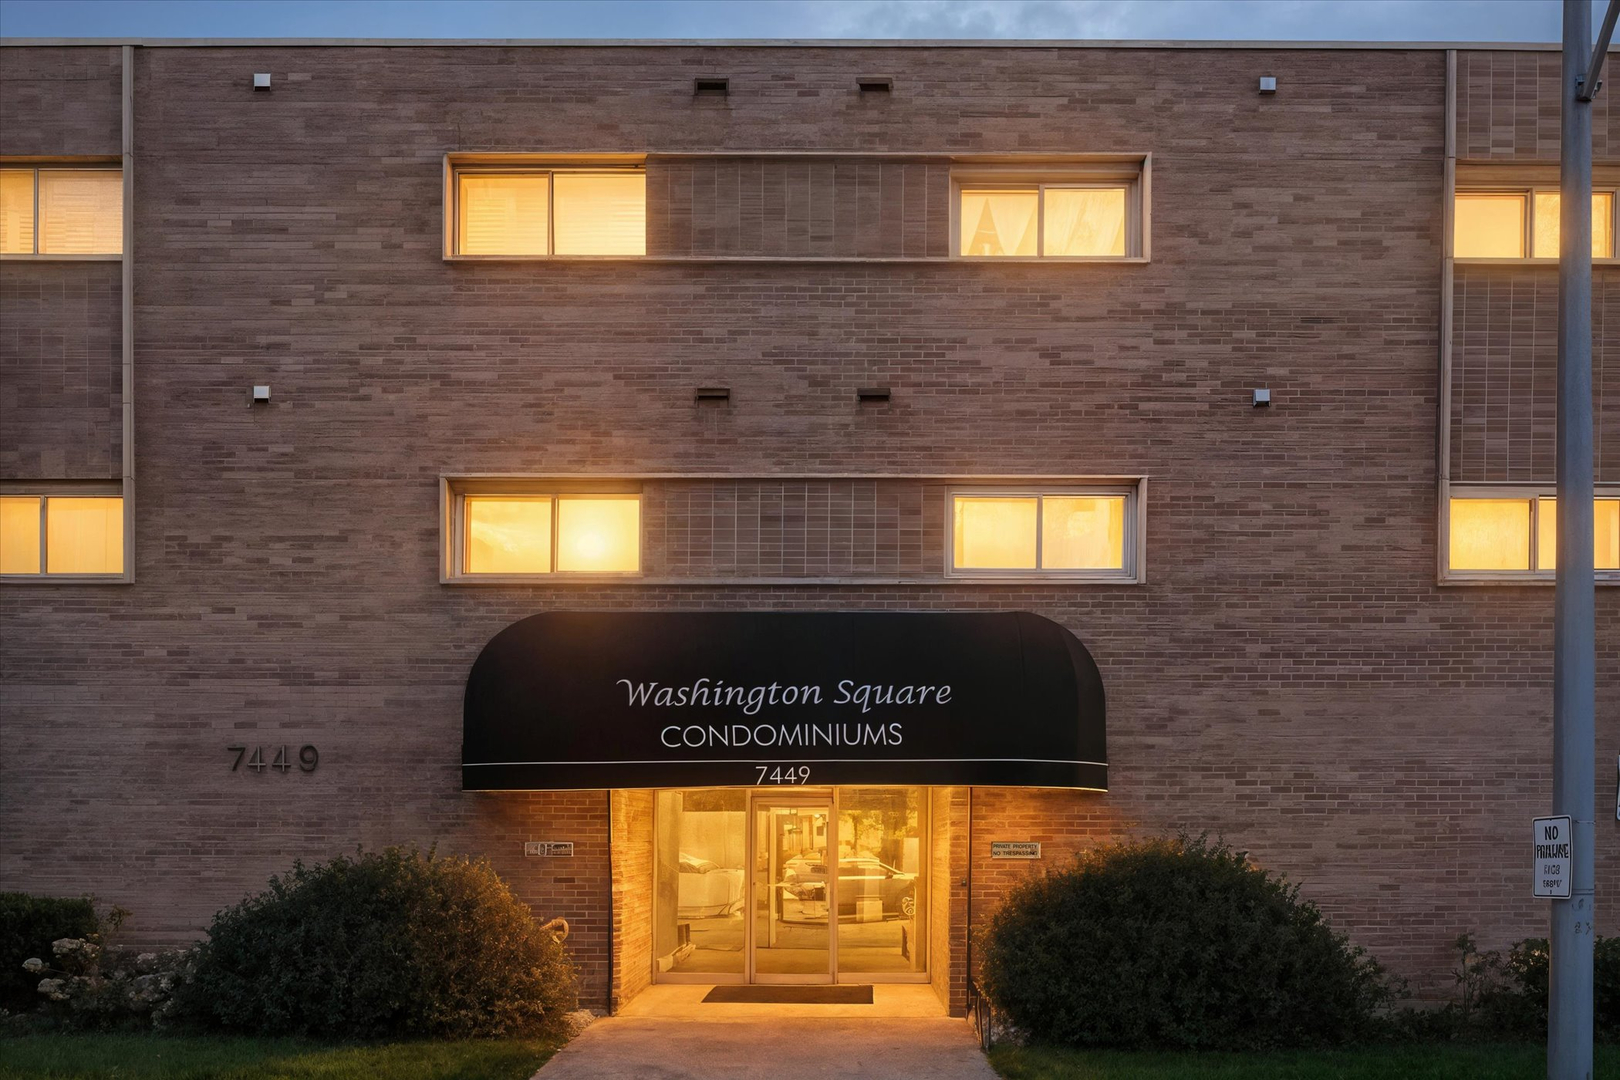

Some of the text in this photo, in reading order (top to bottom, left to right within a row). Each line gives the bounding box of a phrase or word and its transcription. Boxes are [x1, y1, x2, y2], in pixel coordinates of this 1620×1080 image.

[616, 678, 952, 715] Washington Square
[661, 723, 903, 748] CONDOMINIUMS
[227, 744, 319, 773] 7449
[755, 765, 811, 785] 7449
[1544, 825, 1559, 841] NO
